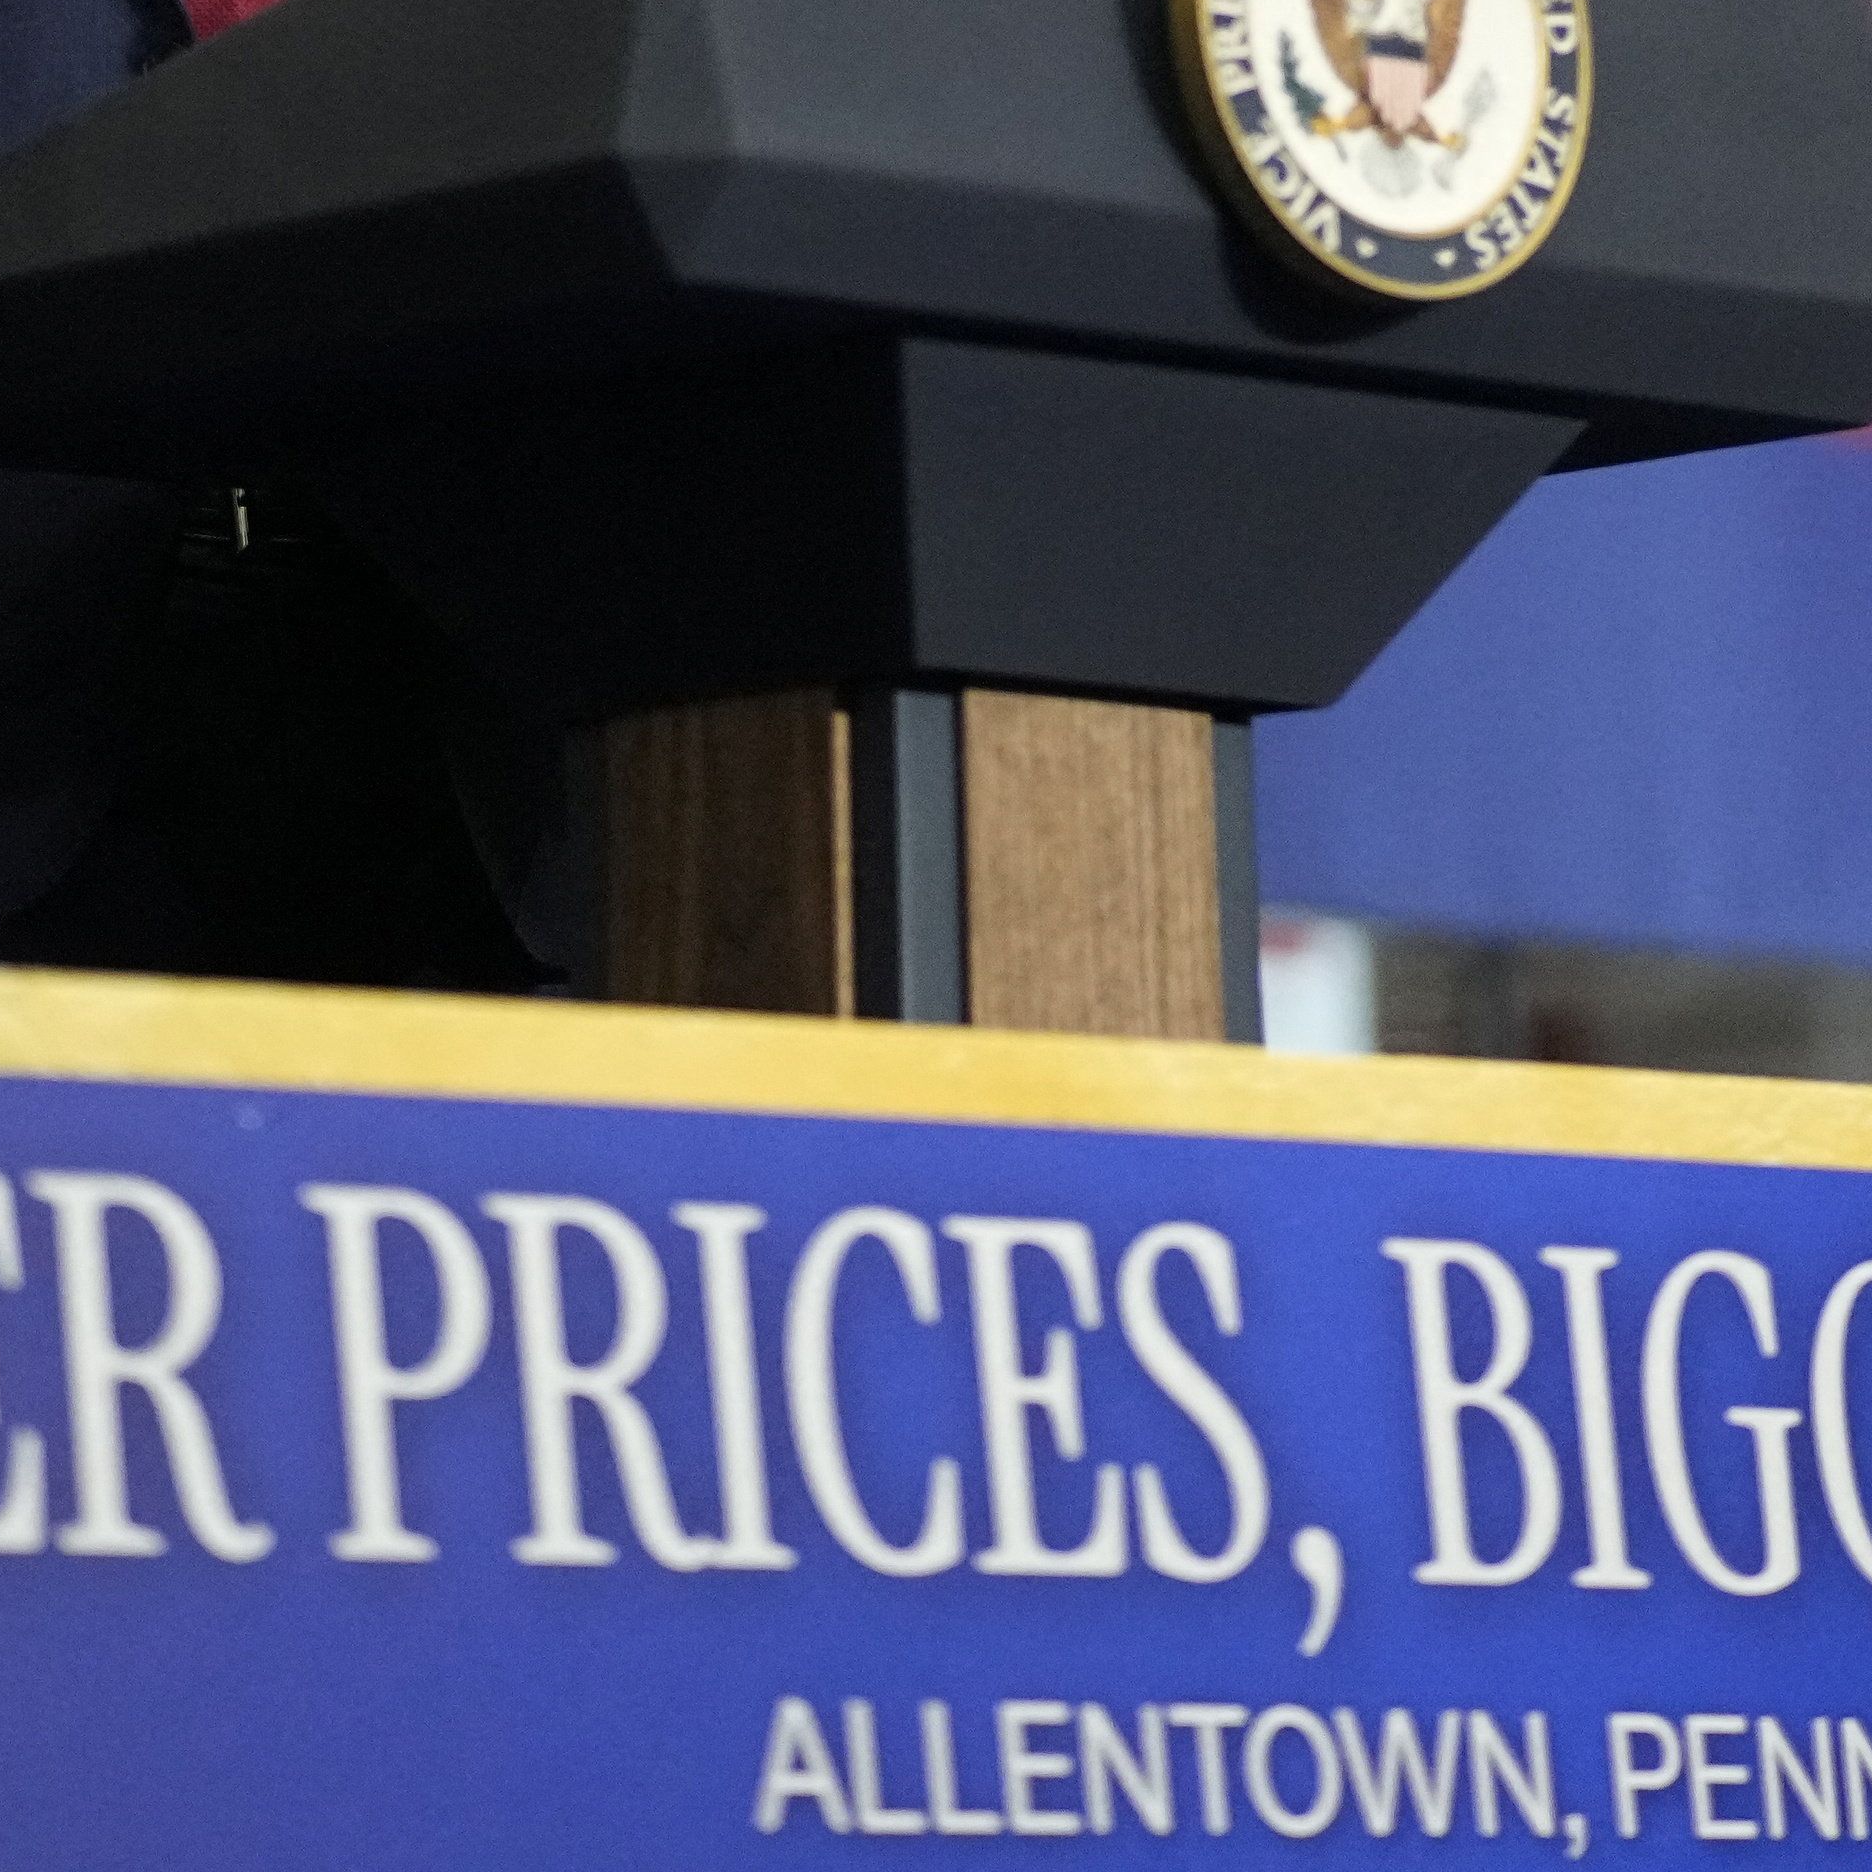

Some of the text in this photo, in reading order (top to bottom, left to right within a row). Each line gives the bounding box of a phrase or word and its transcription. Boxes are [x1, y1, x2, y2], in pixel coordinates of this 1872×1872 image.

[1248, 126, 1343, 253] VICE
[1467, 87, 1576, 269] STATES
[296, 1182, 1346, 1658] PRICES,
[751, 1696, 1589, 1859] ALLENTOWN,
